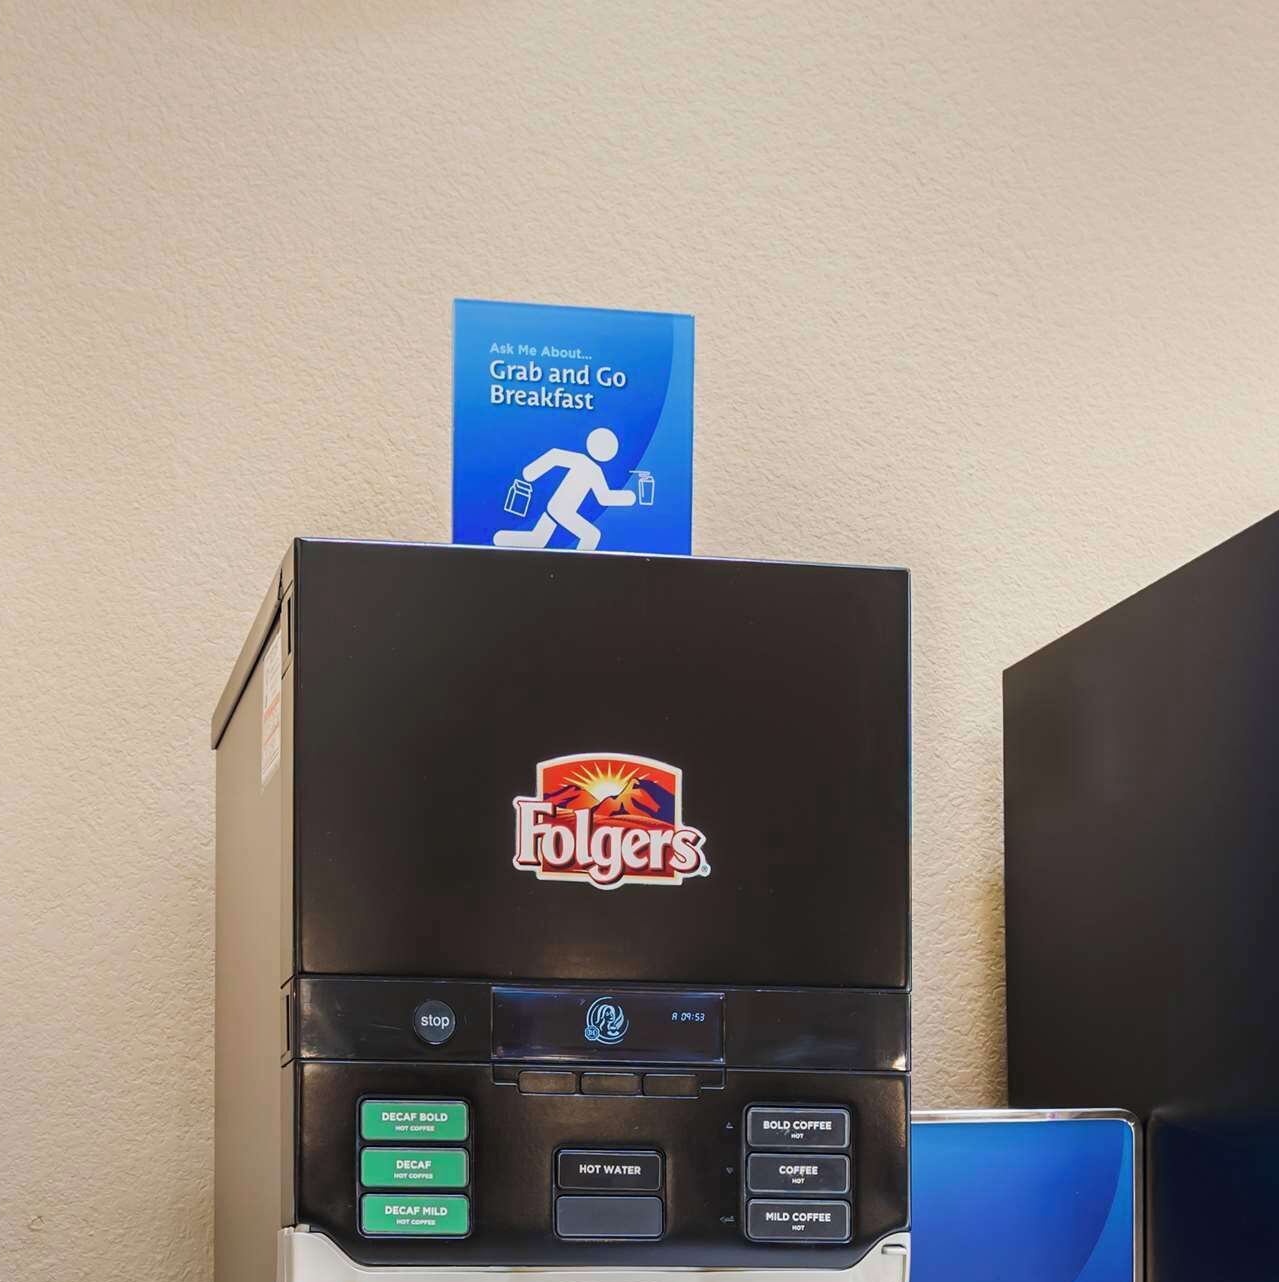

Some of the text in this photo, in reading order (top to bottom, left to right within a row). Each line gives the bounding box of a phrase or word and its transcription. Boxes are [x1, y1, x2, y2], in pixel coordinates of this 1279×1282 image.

[489, 342, 592, 360] Ask Me About...
[489, 360, 627, 388] Grab and Go
[490, 384, 594, 410] Breakfast
[516, 801, 701, 884] Folgers
[681, 1012, 705, 1021] 09:53
[421, 1014, 450, 1030] stop
[382, 1112, 448, 1122] DECAF BOLD
[763, 1120, 832, 1130] BOLD COFFEE
[396, 1160, 432, 1169] DECAF
[579, 1164, 641, 1175] HOT WATER
[779, 1166, 818, 1175] COFFEE
[384, 1206, 448, 1216] DECAF MILD
[765, 1212, 832, 1222] MILD COFFEE
